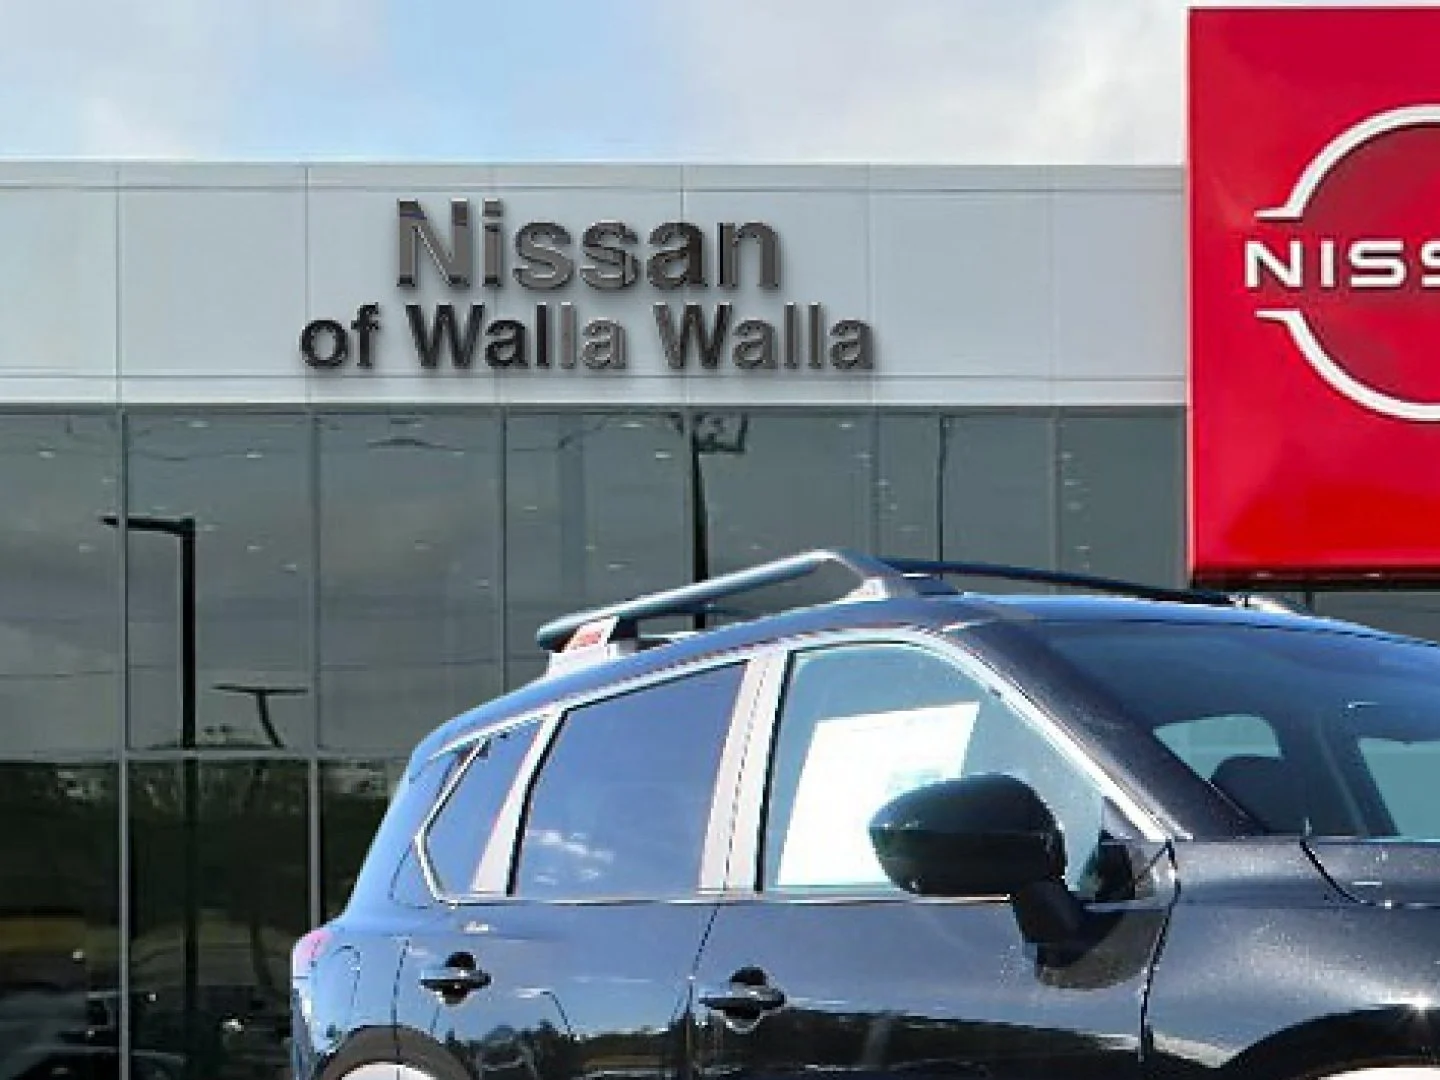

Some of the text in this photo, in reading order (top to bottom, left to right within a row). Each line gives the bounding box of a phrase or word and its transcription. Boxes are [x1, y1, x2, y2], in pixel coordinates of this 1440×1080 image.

[396, 198, 782, 290] Nissan
[299, 302, 873, 371] of Walla Walla
